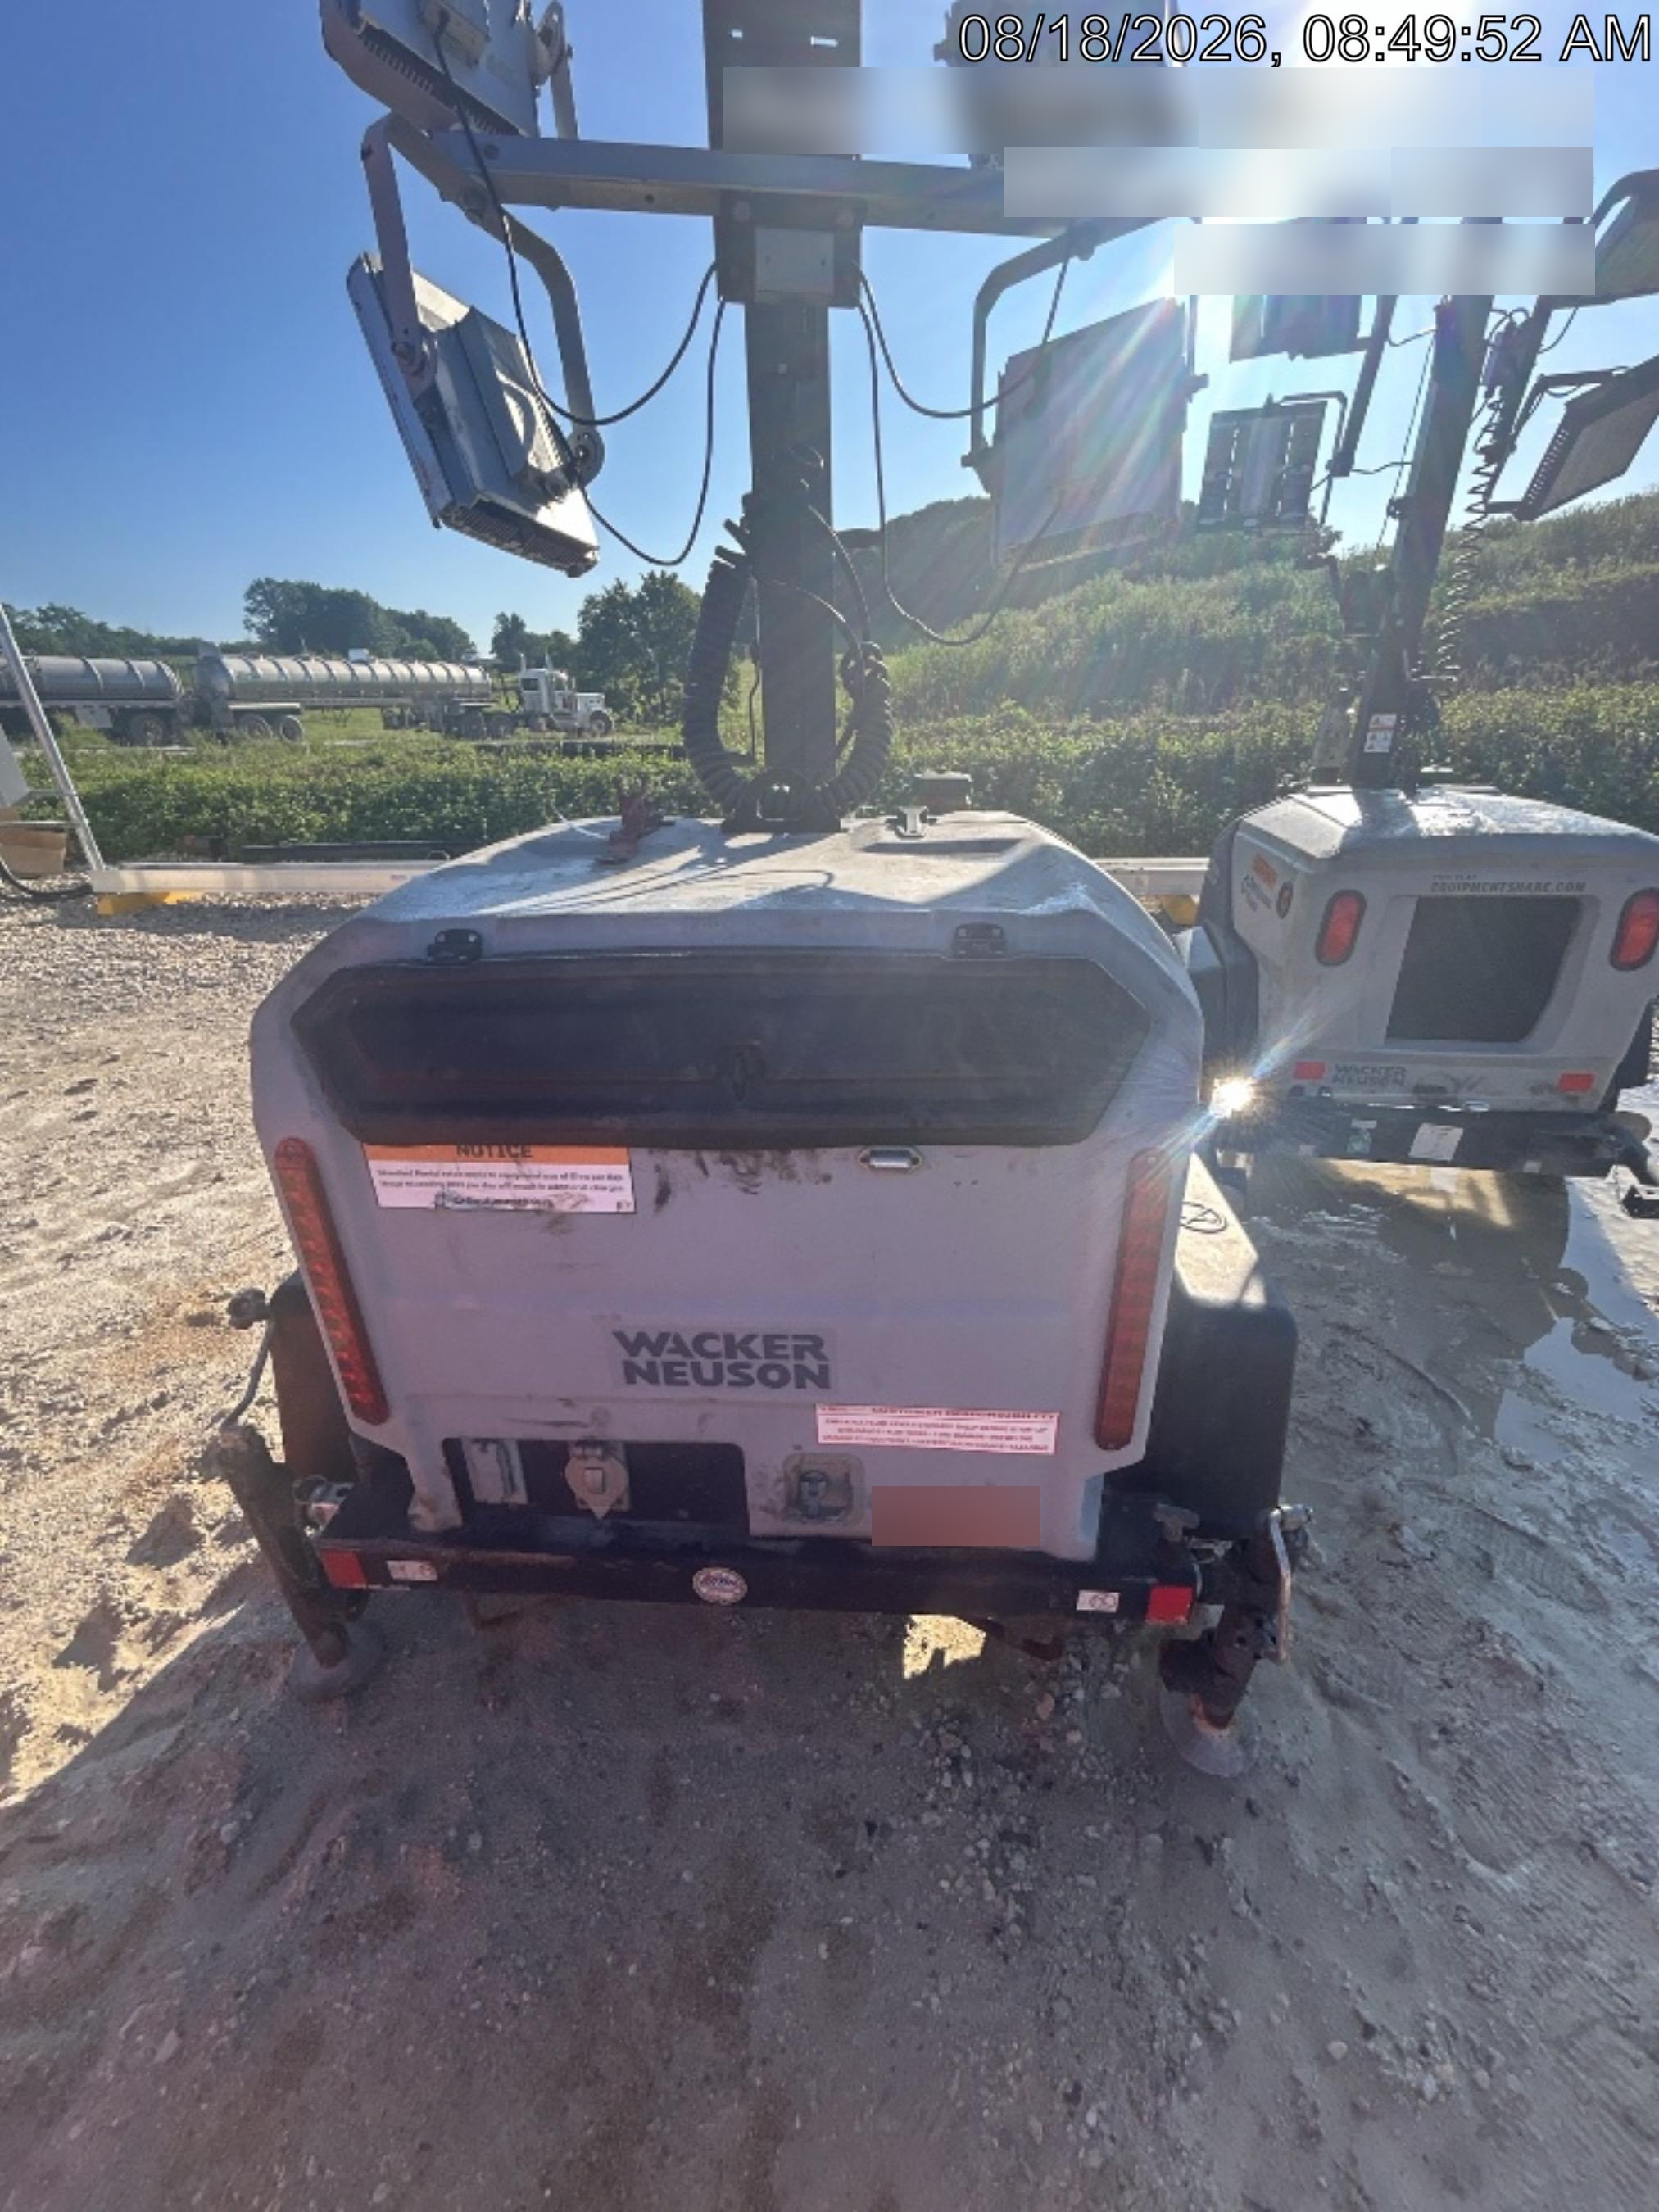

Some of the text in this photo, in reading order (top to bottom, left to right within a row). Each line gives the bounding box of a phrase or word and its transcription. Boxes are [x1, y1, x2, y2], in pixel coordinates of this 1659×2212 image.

[456, 1145, 533, 1158] NOTICE
[611, 1330, 831, 1362] WACKER
[621, 1359, 831, 1389] NEUSON
